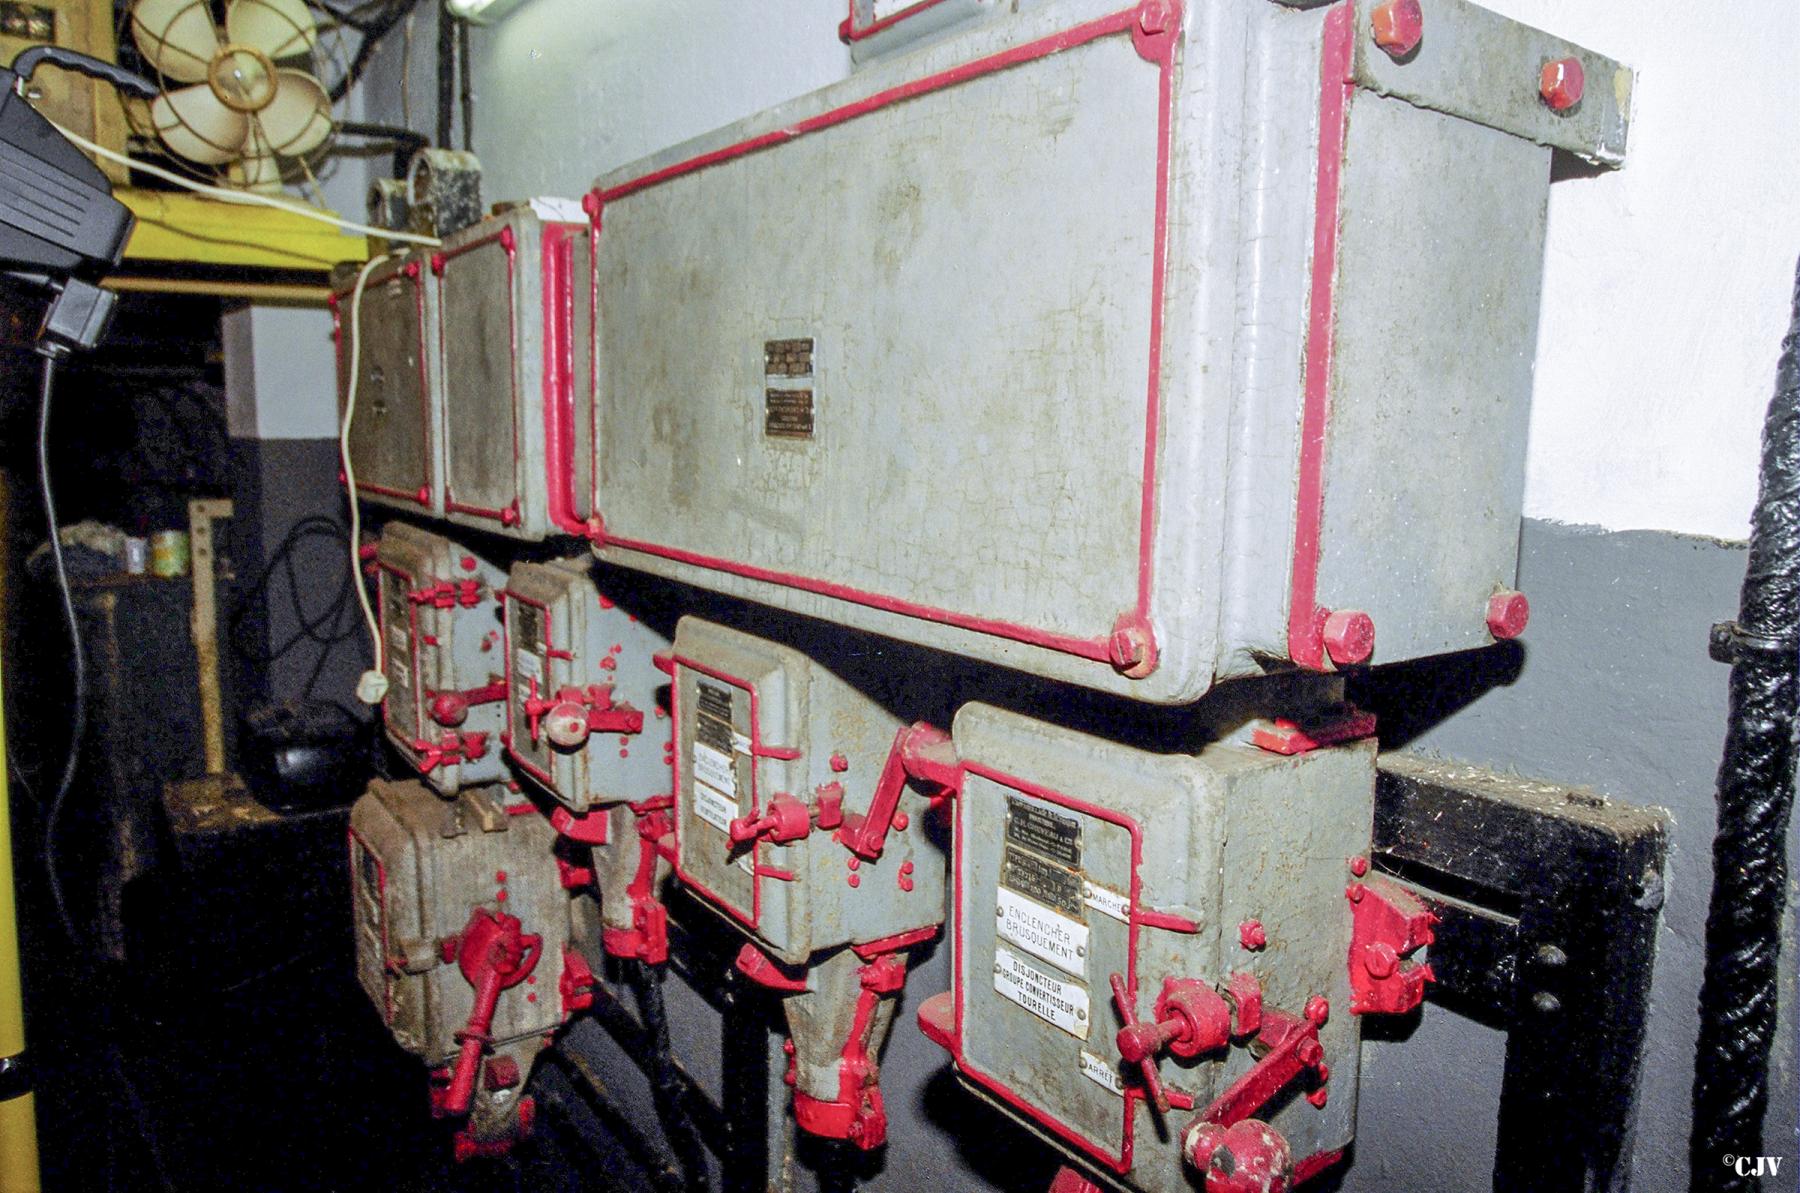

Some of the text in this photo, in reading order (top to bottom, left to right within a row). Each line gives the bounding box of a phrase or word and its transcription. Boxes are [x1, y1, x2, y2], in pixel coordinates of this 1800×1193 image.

[1092, 893, 1121, 913] MARCHE
[1006, 918, 1073, 960] BRUSQUEMENT
[1009, 905, 1071, 945] ENCLENCHER
[1002, 968, 1074, 1017] GROUPE CONVERTISSEUR
[1012, 960, 1062, 996] DISJONCTEUR
[1017, 990, 1056, 1021] TOURELLE
